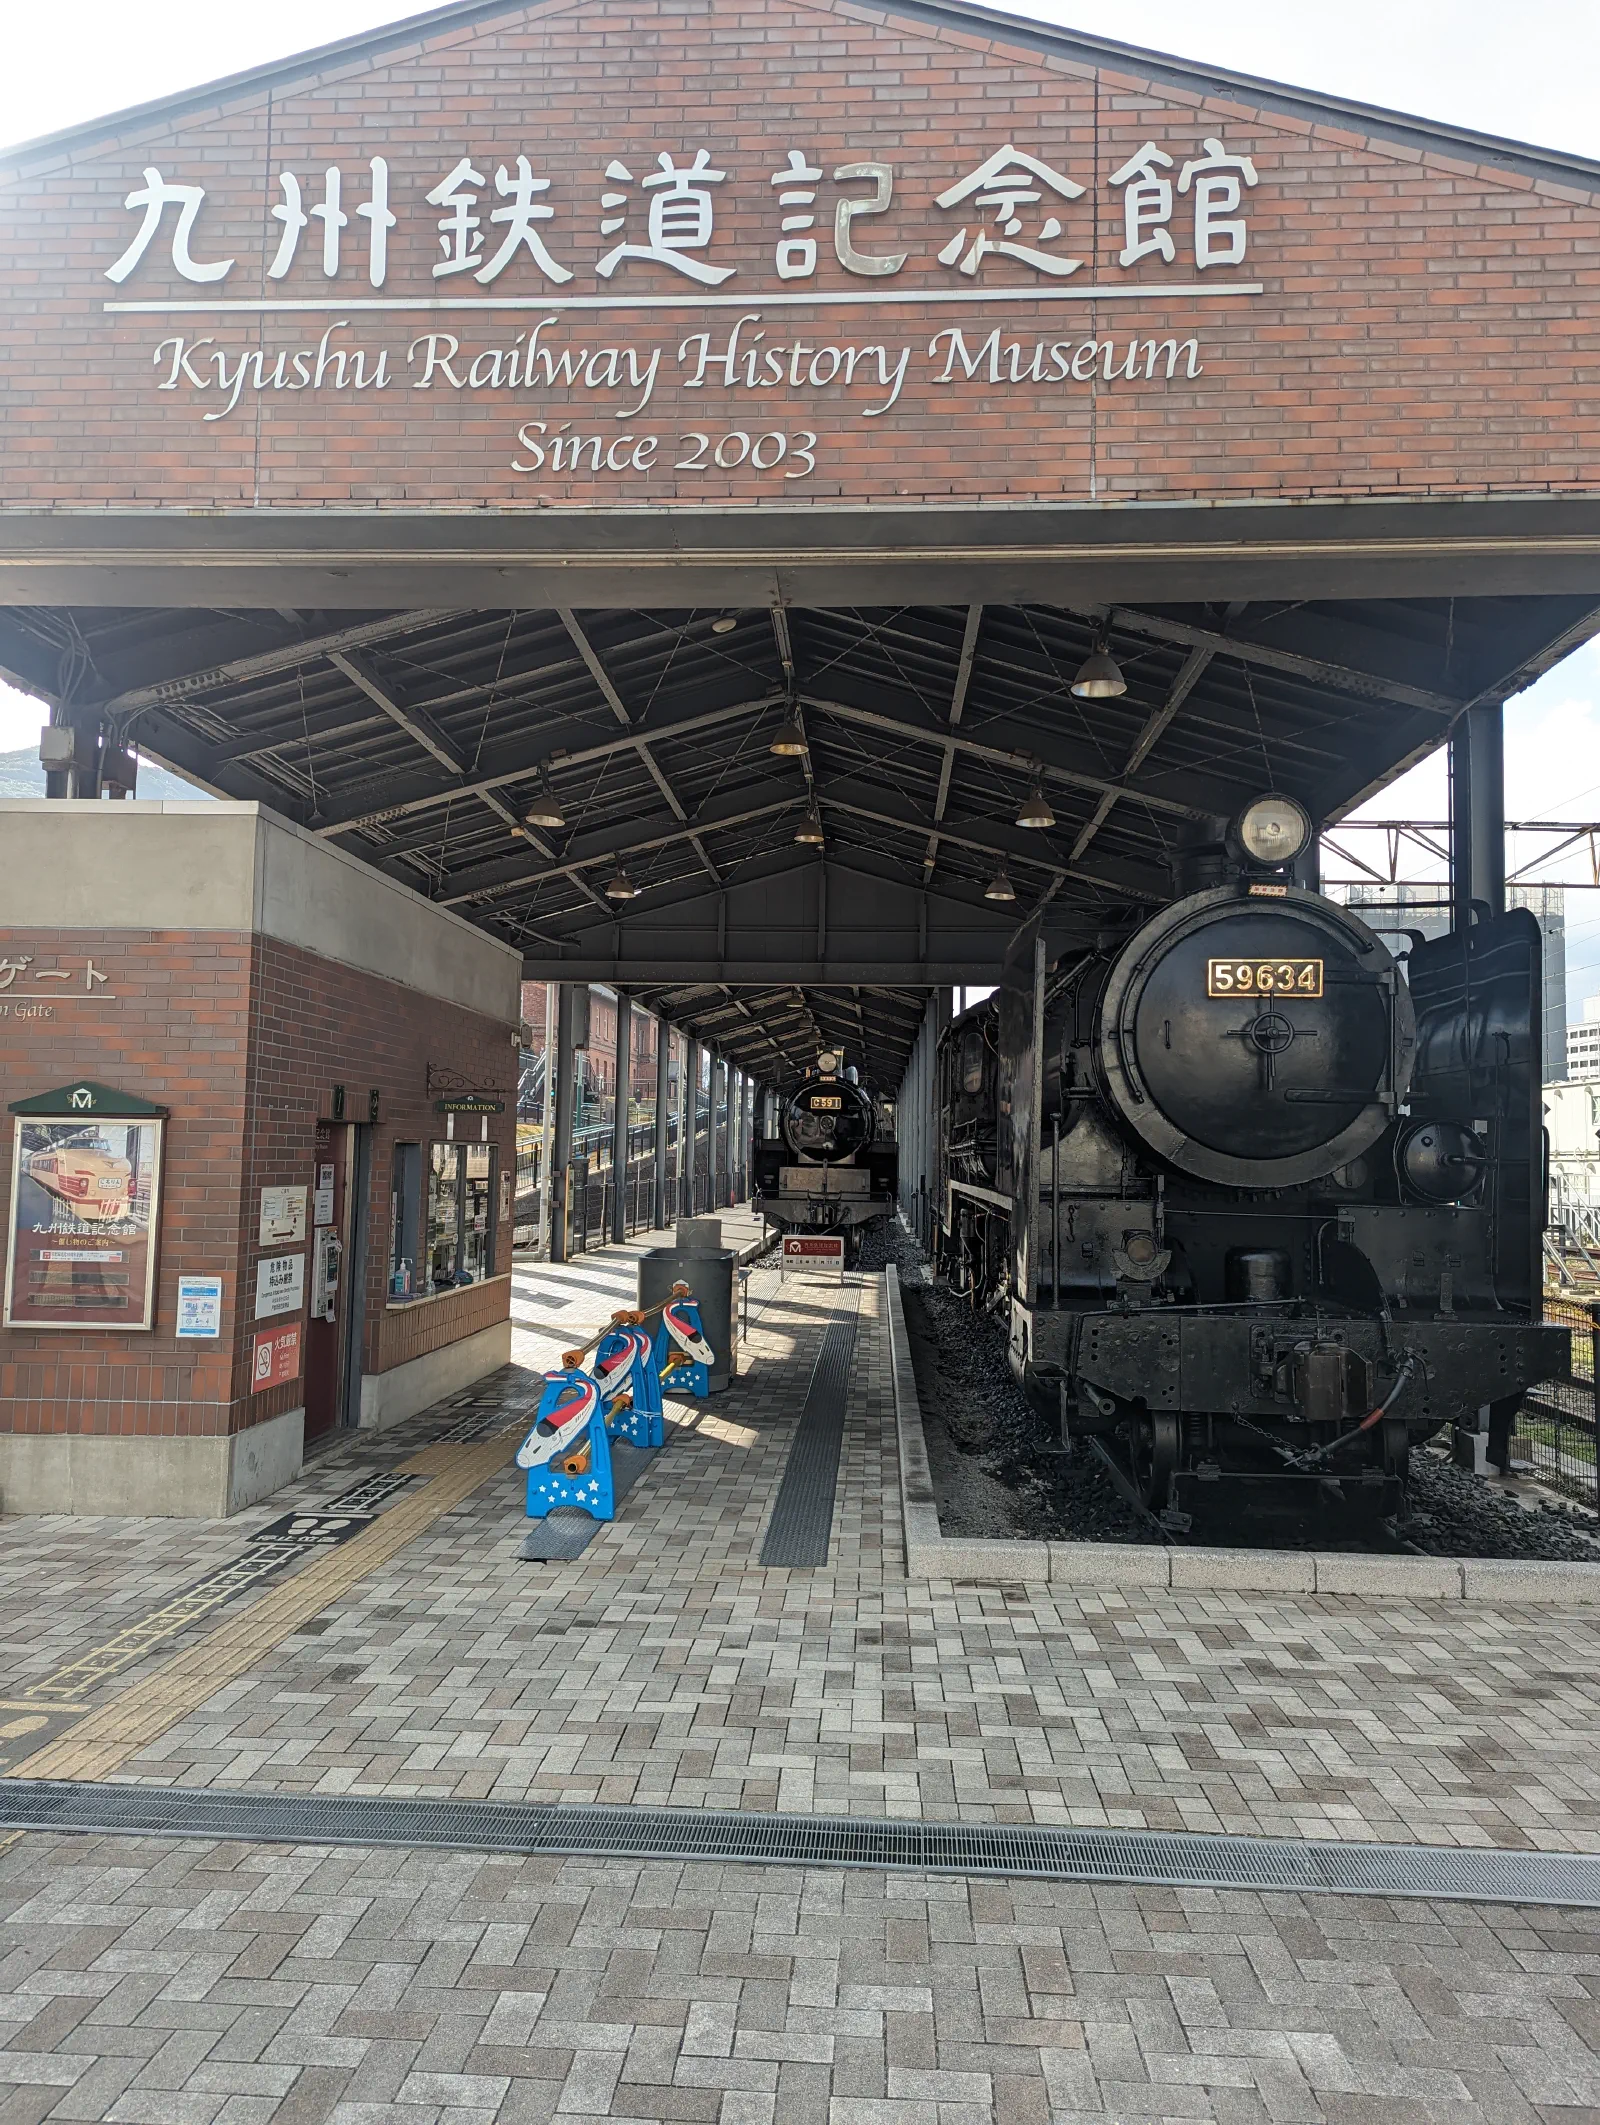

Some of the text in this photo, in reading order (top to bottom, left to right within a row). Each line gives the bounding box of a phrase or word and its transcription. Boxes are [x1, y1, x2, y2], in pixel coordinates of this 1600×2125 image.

[104, 138, 1258, 288] 九州鉄道記念館
[153, 313, 1203, 421] Kyushu Railway History Museum
[511, 422, 818, 478] Since 2003
[1215, 965, 1315, 991] 59634
[15, 1002, 53, 1022] Gate
[444, 1103, 496, 1111] INFORMATION
[32, 1222, 136, 1236] 九州鉄道記念館
[270, 1259, 293, 1274] 危険物品
[275, 1332, 297, 1350] 火気厳禁
[256, 1534, 341, 1543] 停止位置
